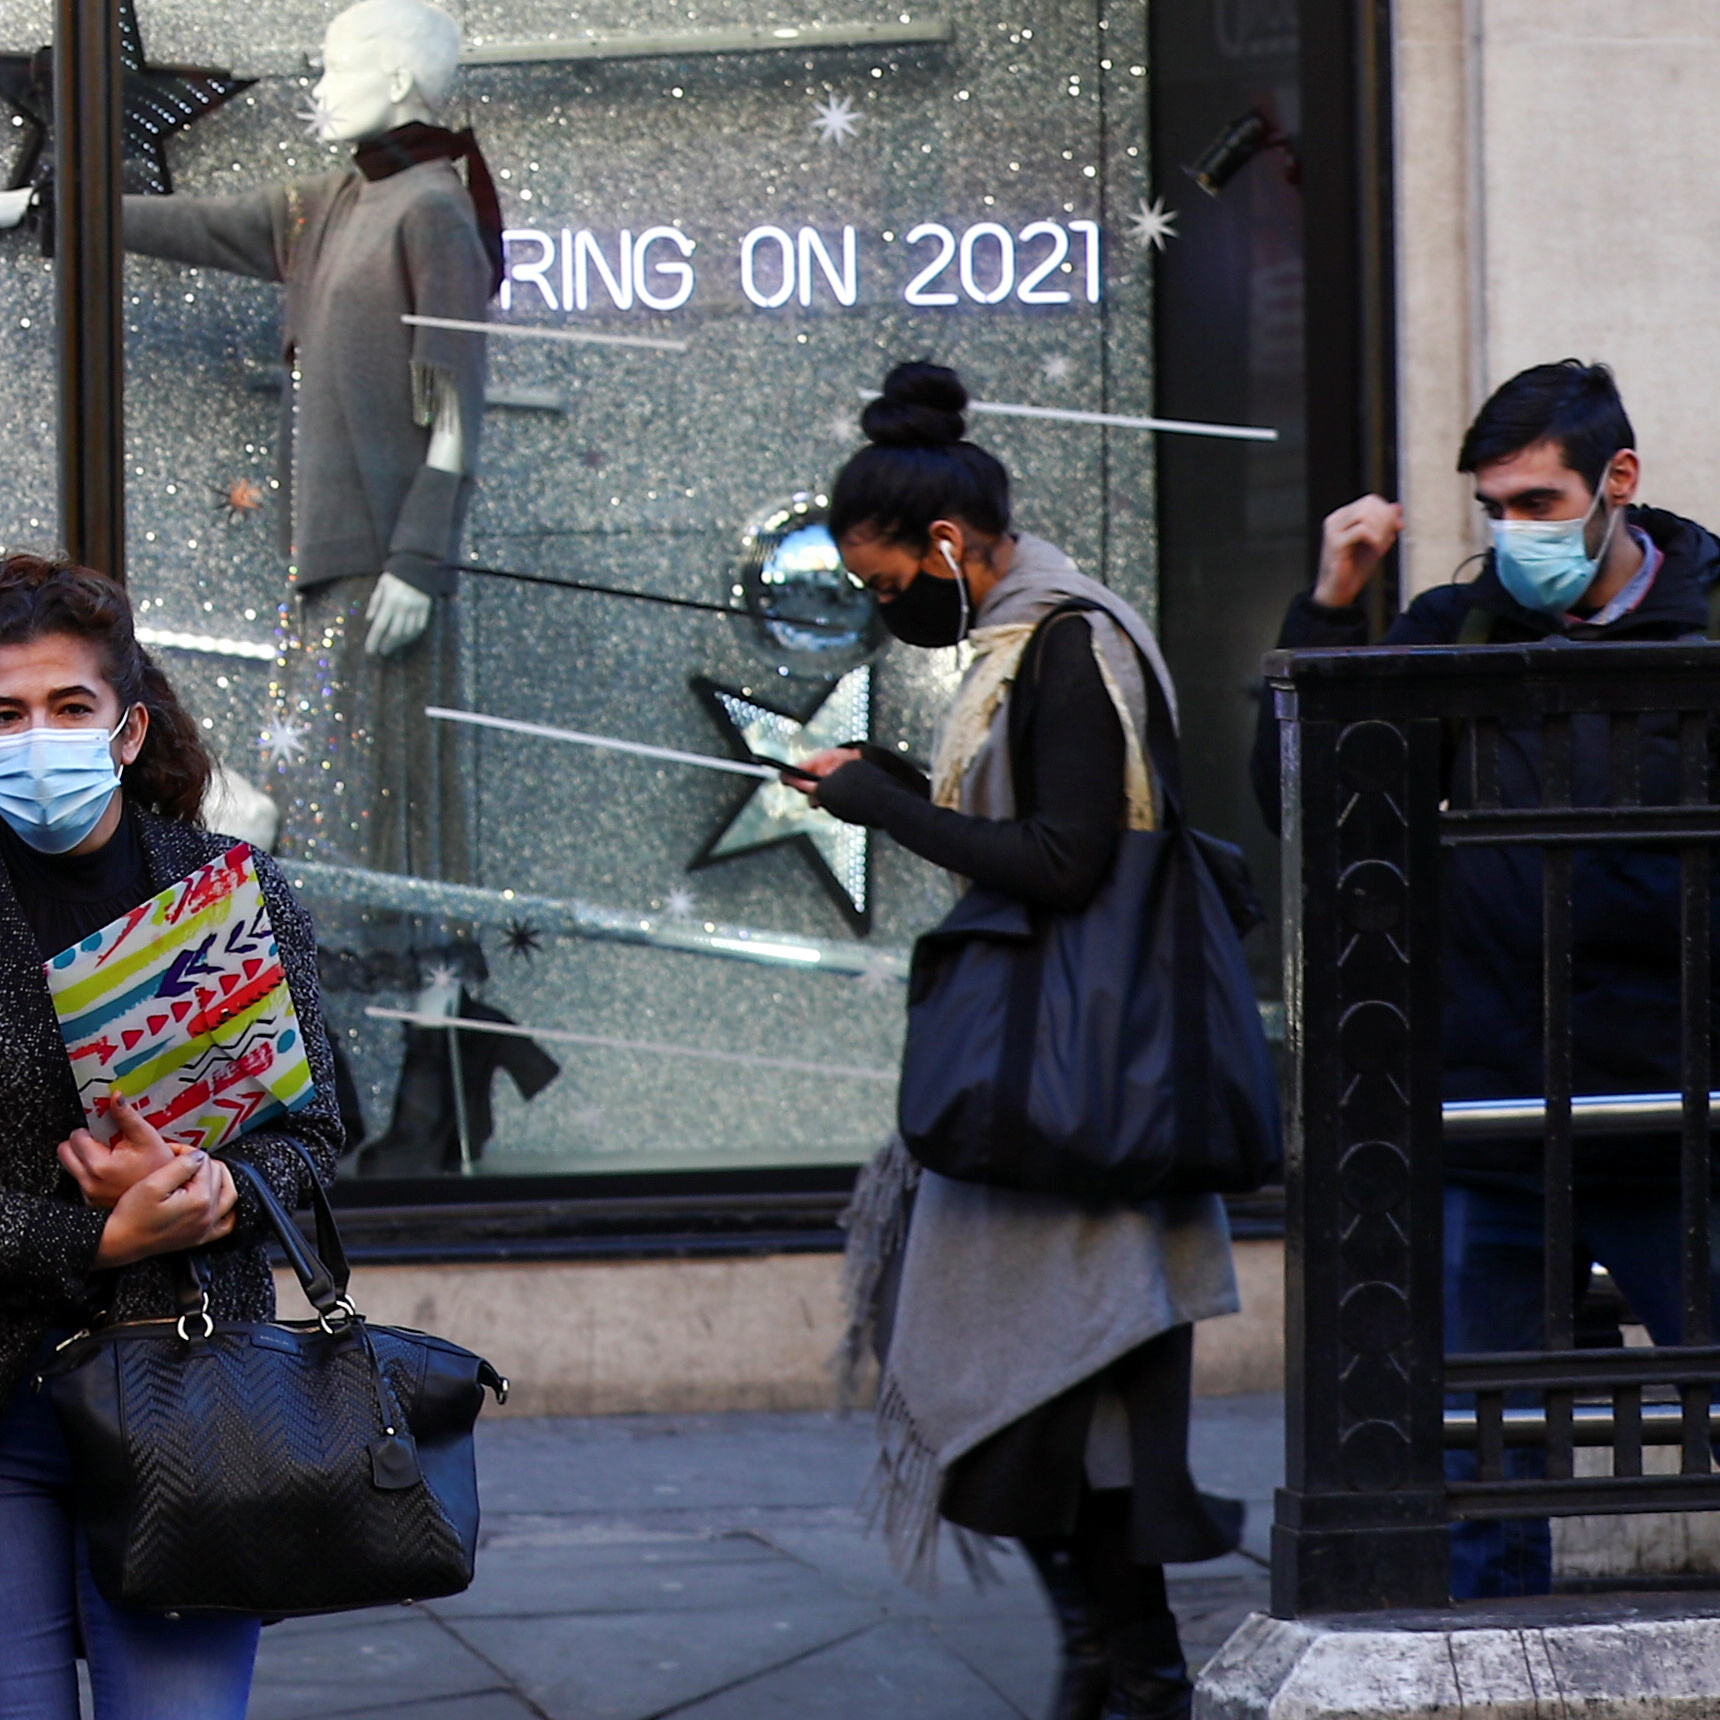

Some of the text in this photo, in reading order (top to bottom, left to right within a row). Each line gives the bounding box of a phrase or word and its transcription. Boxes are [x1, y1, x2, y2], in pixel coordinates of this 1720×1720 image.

[500, 221, 1101, 311] RING ON 2021
